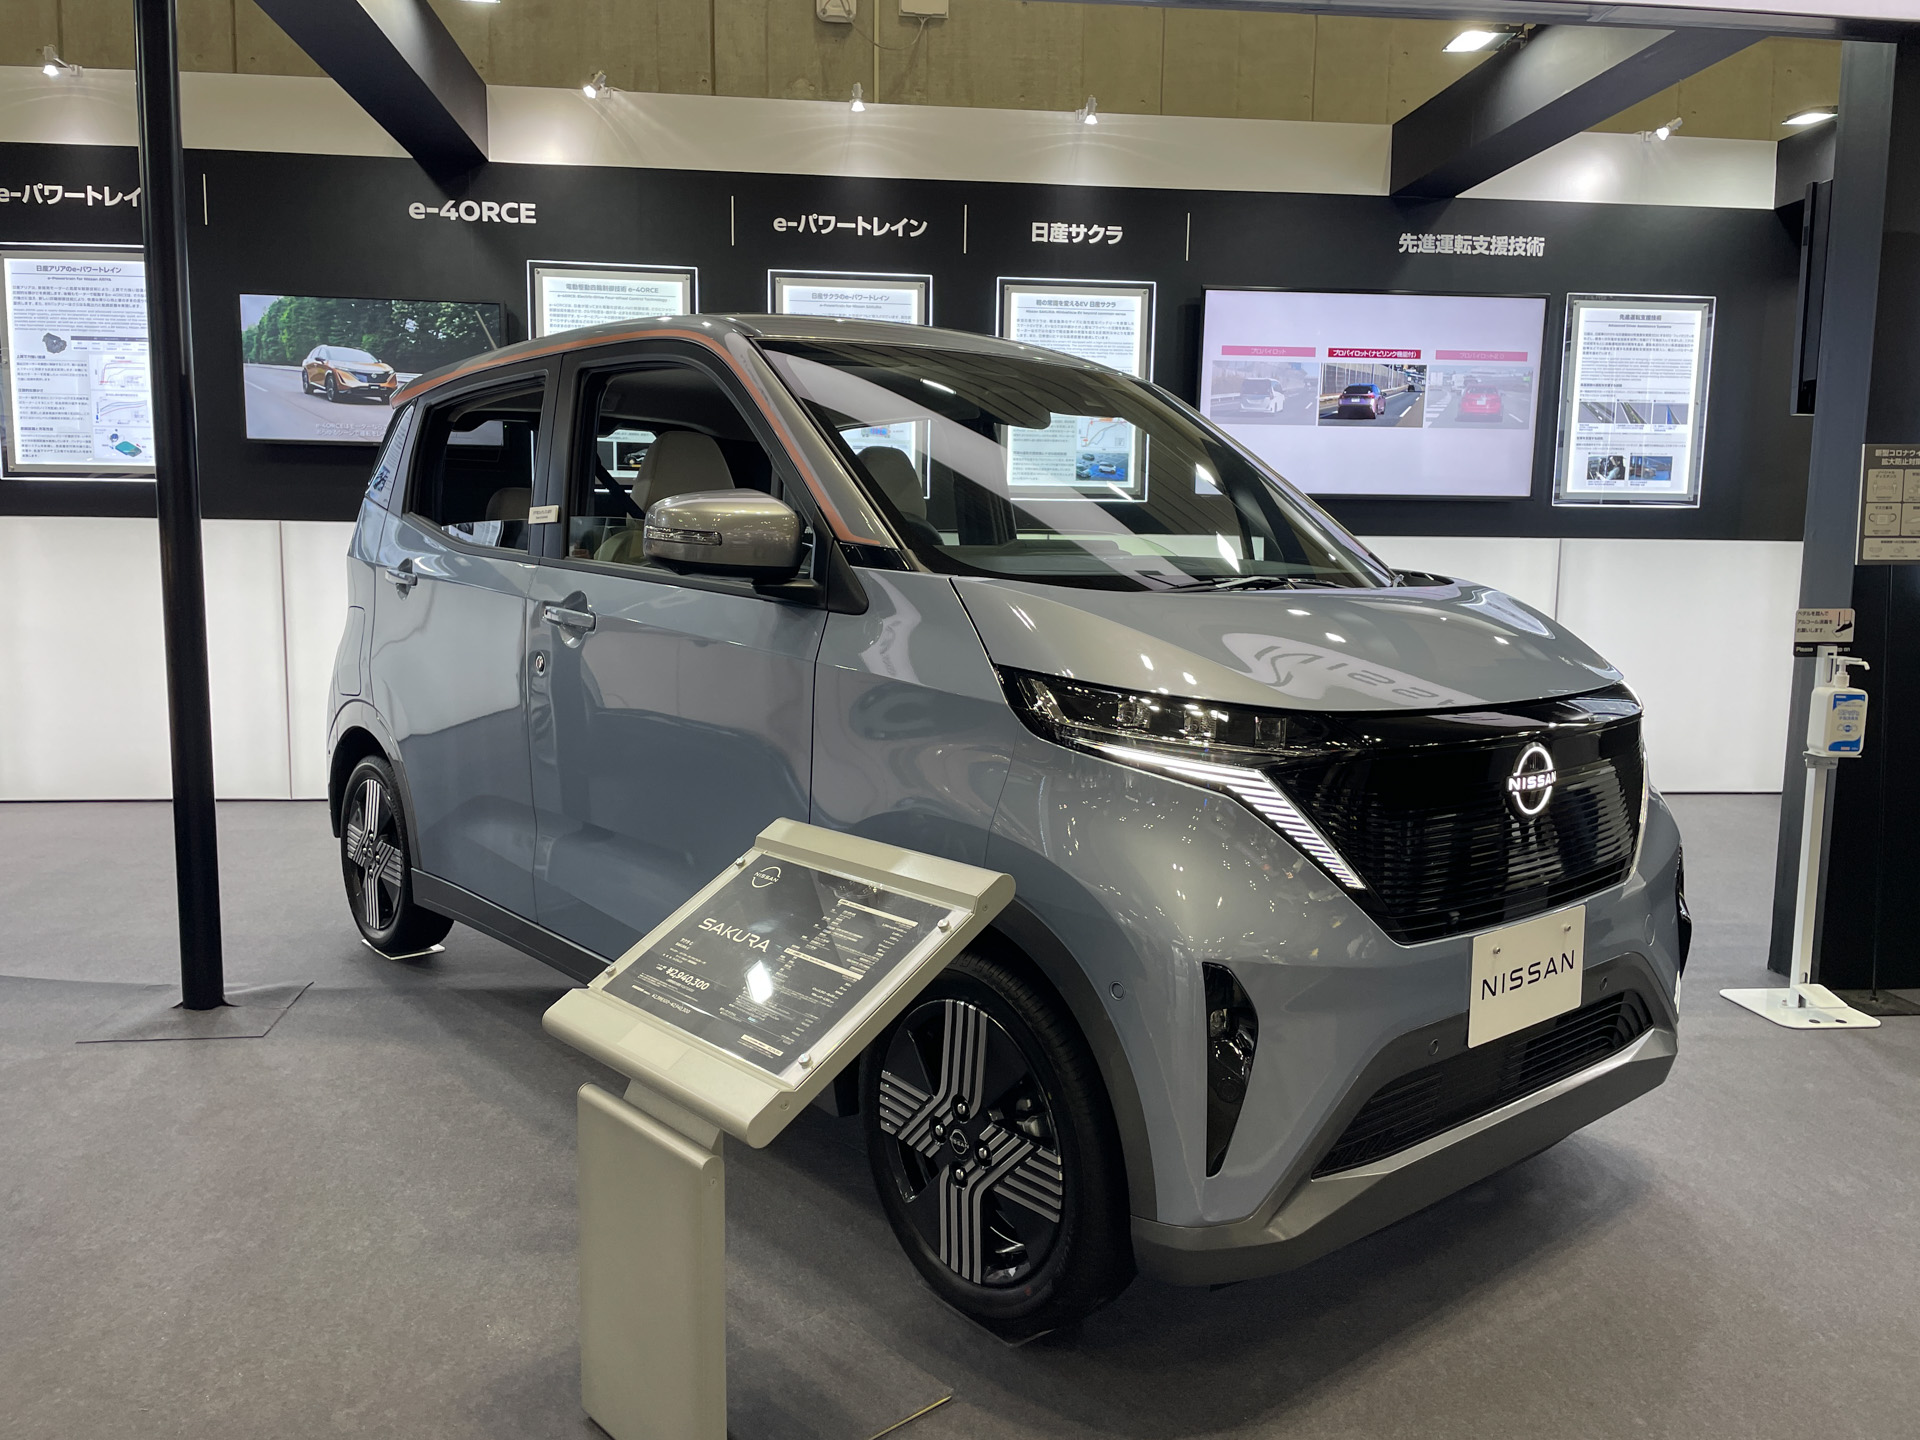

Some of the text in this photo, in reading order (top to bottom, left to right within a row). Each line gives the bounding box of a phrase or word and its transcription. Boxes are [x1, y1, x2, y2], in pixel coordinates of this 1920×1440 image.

[408, 200, 537, 224] e-4ORCE
[773, 213, 928, 237] e-パワートレイン
[1031, 222, 1124, 245] 日産サクラ
[1398, 233, 1546, 257] 先進運転支援技術
[36, 264, 122, 274] 日産アリアのe-パワートレイン
[628, 286, 659, 294] e-4ORCE
[811, 292, 890, 301] 日産サクラのe-パワートレイン
[1507, 769, 1557, 792] NISSAN
[753, 871, 779, 883] NISSAN
[698, 917, 770, 953] SAKURA
[665, 966, 710, 991] ¥2,940,300
[1481, 949, 1575, 1001] NISSAN
